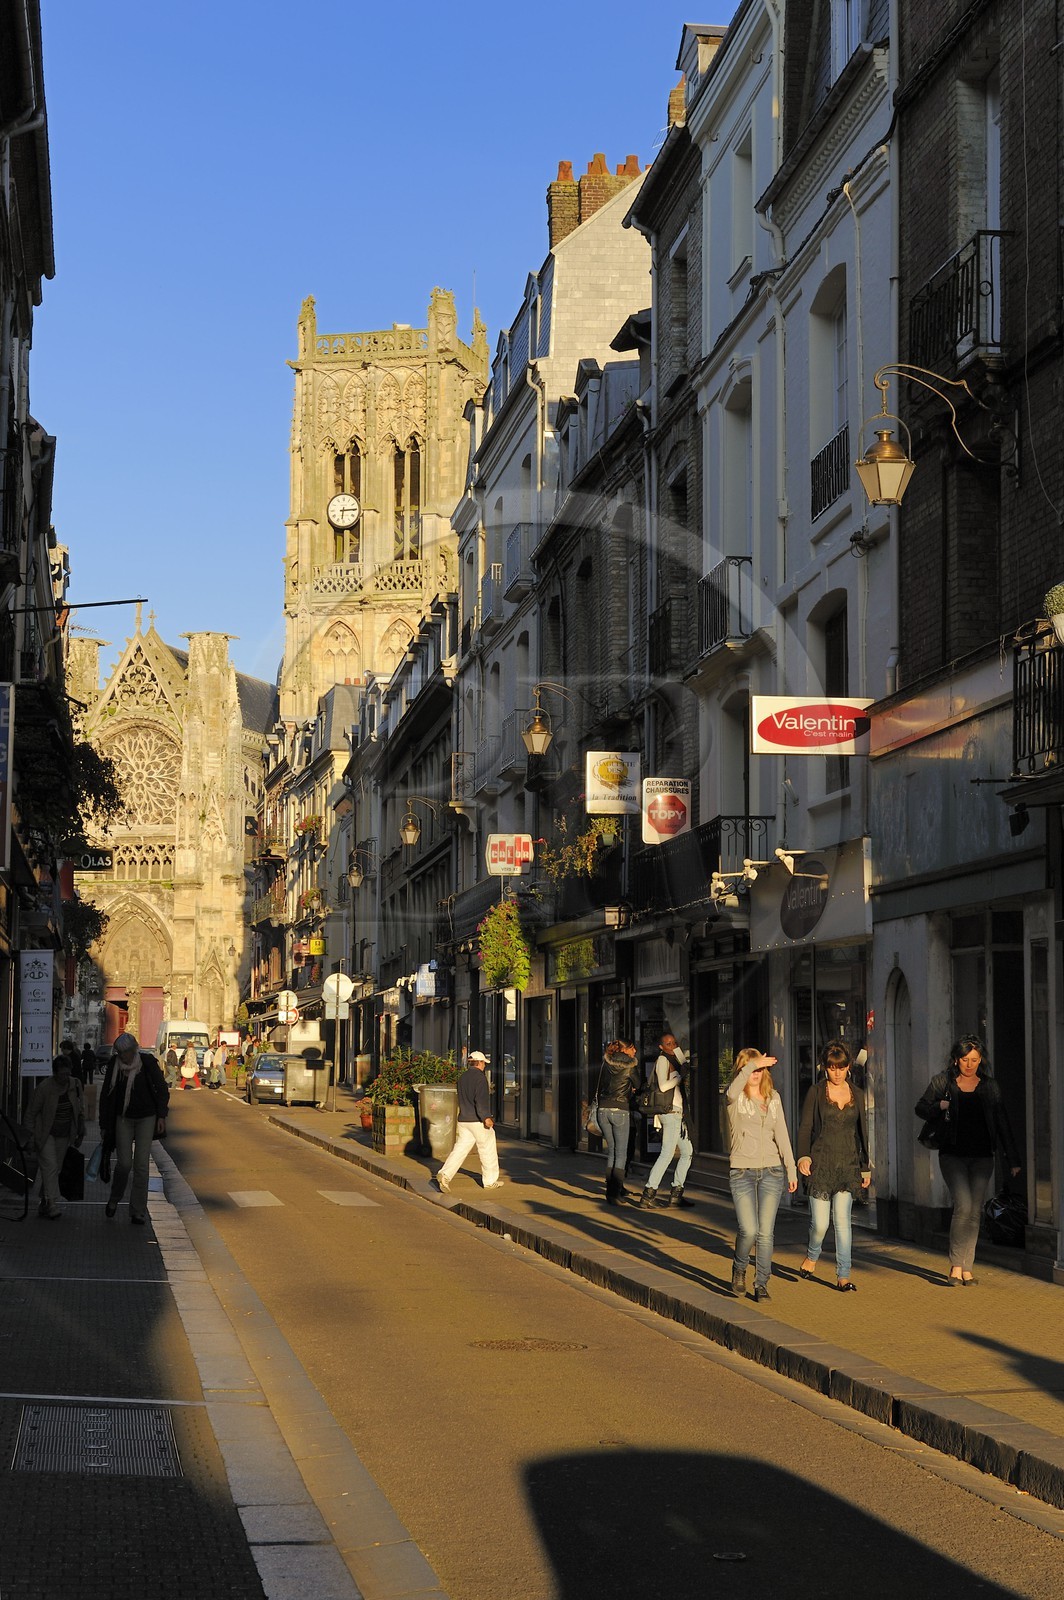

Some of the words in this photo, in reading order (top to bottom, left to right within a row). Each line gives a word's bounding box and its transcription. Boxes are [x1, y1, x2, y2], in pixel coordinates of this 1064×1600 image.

[770, 712, 856, 731] Valentin
[645, 787, 690, 795] CHAUSSURES
[603, 793, 637, 801] Tradition
[649, 809, 685, 820] TOPY
[491, 849, 530, 859] CALOR
[785, 879, 822, 911] Valentin
